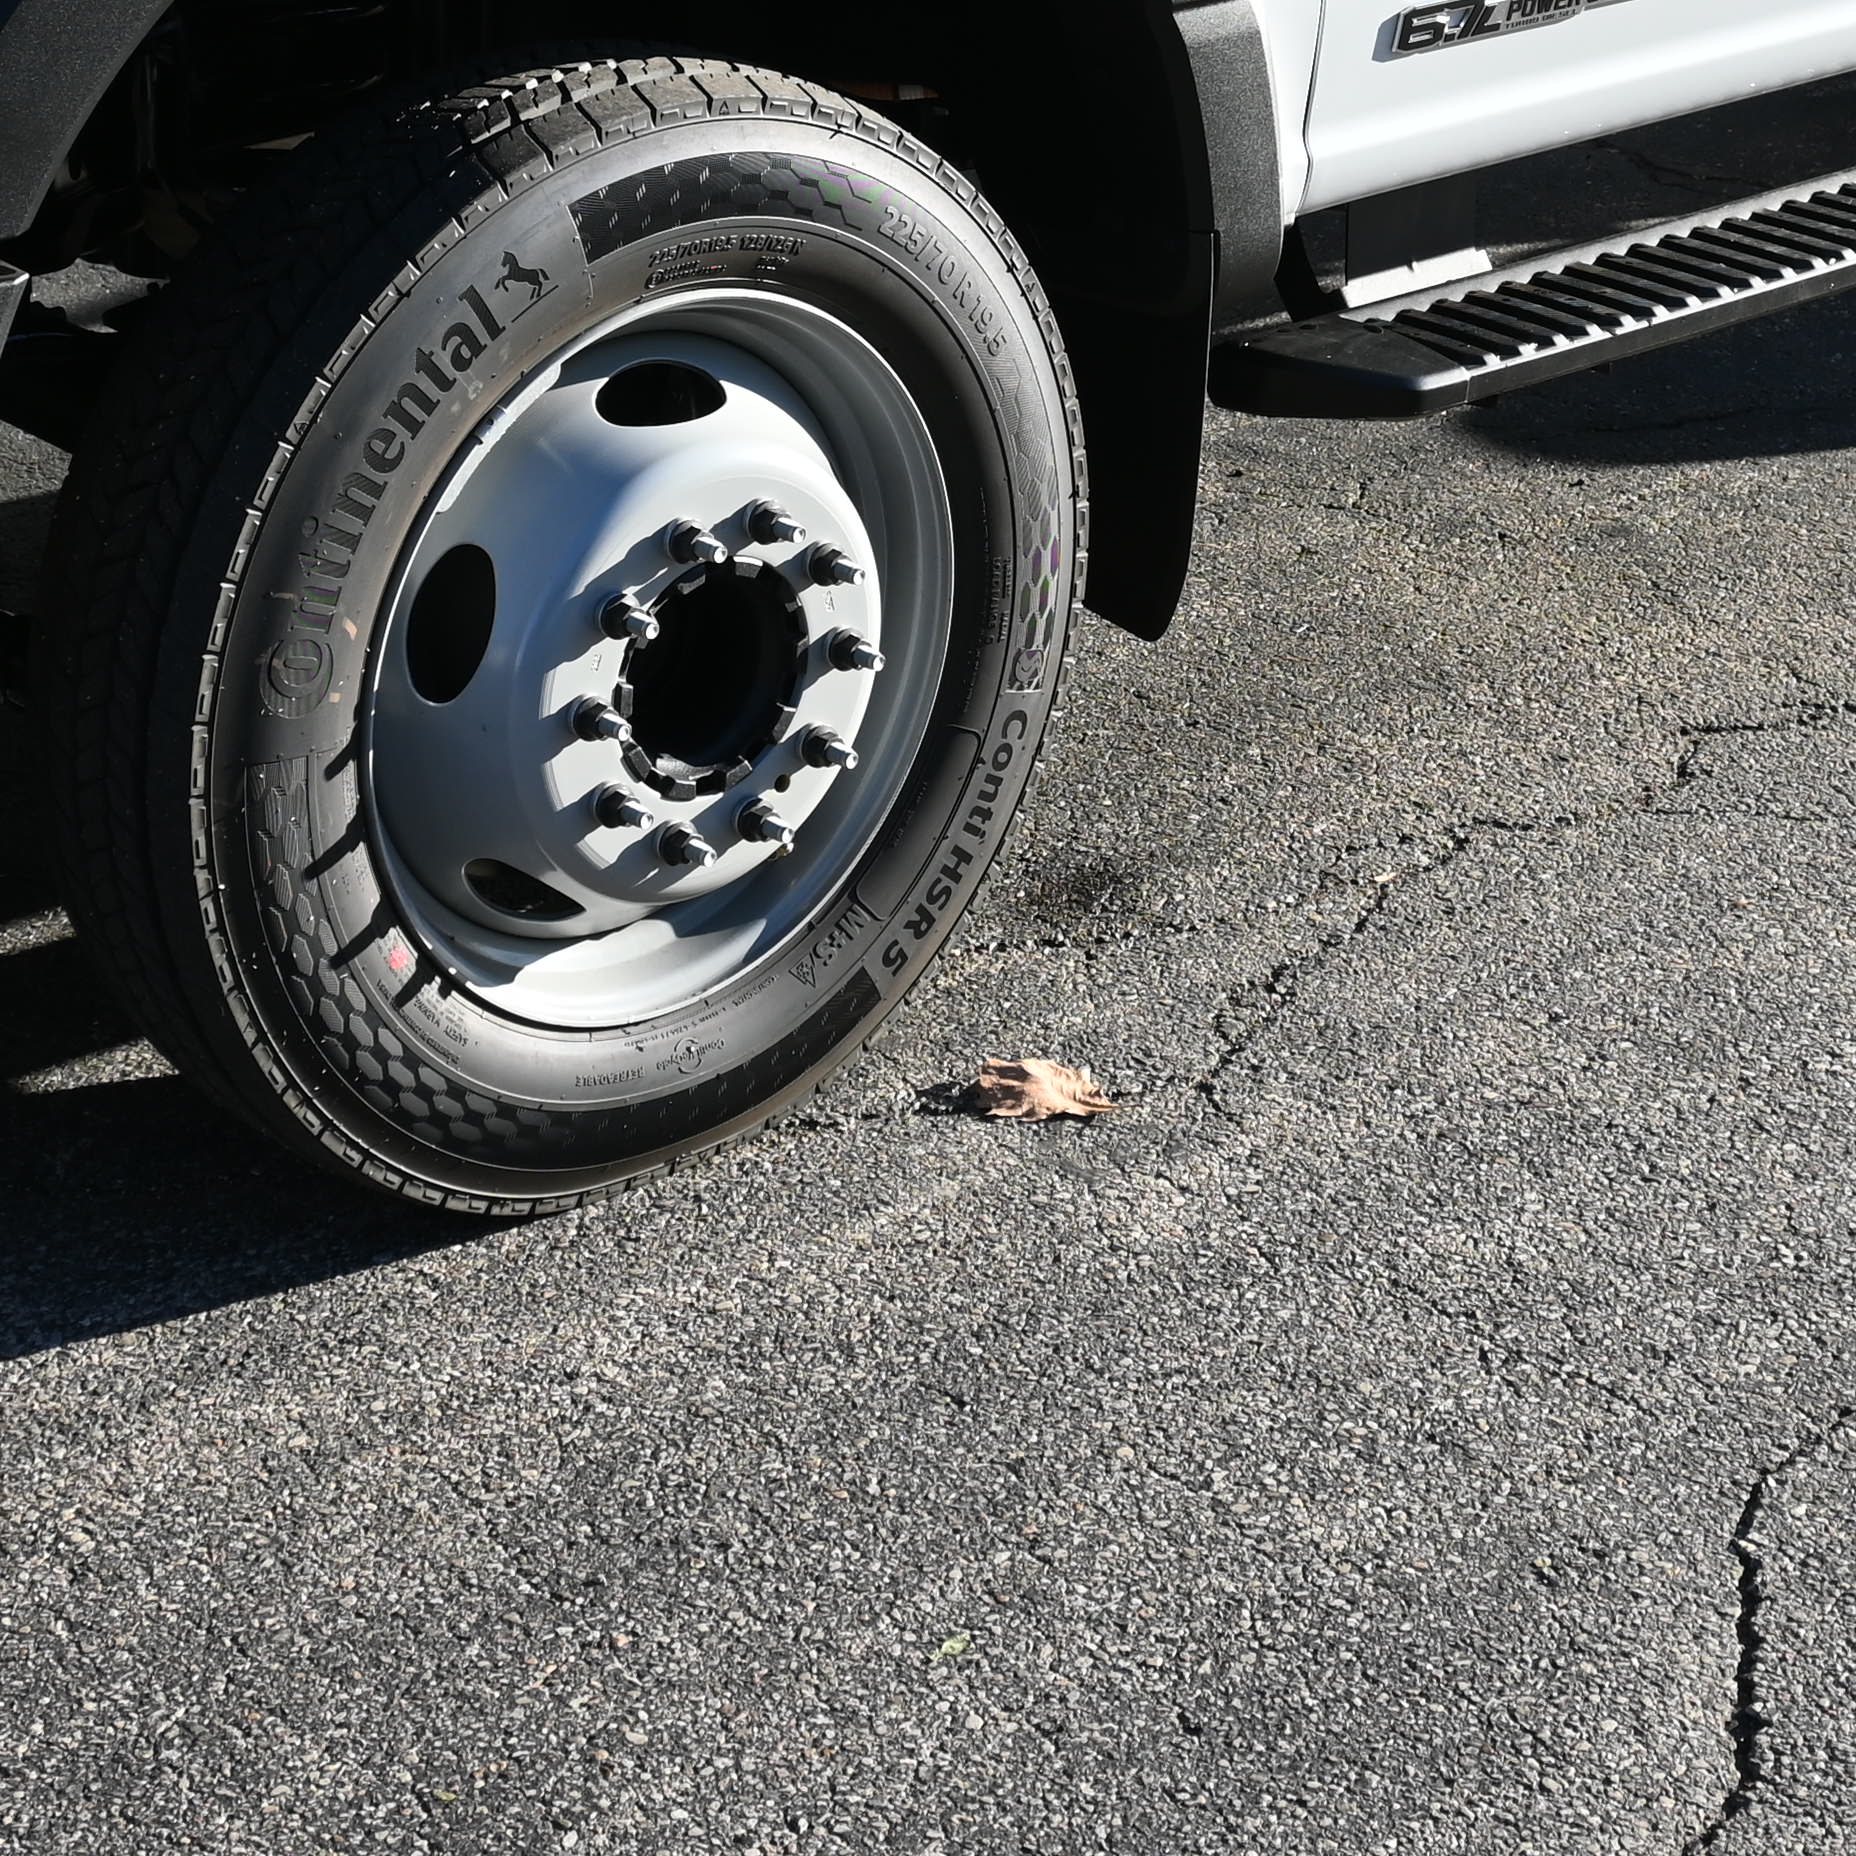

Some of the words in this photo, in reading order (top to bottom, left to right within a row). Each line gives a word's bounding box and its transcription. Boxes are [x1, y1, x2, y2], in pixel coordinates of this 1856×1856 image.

[259, 284, 506, 720] Continental
[962, 709, 1028, 844] Conti
[903, 844, 974, 941] HSR
[881, 939, 909, 976] 5
